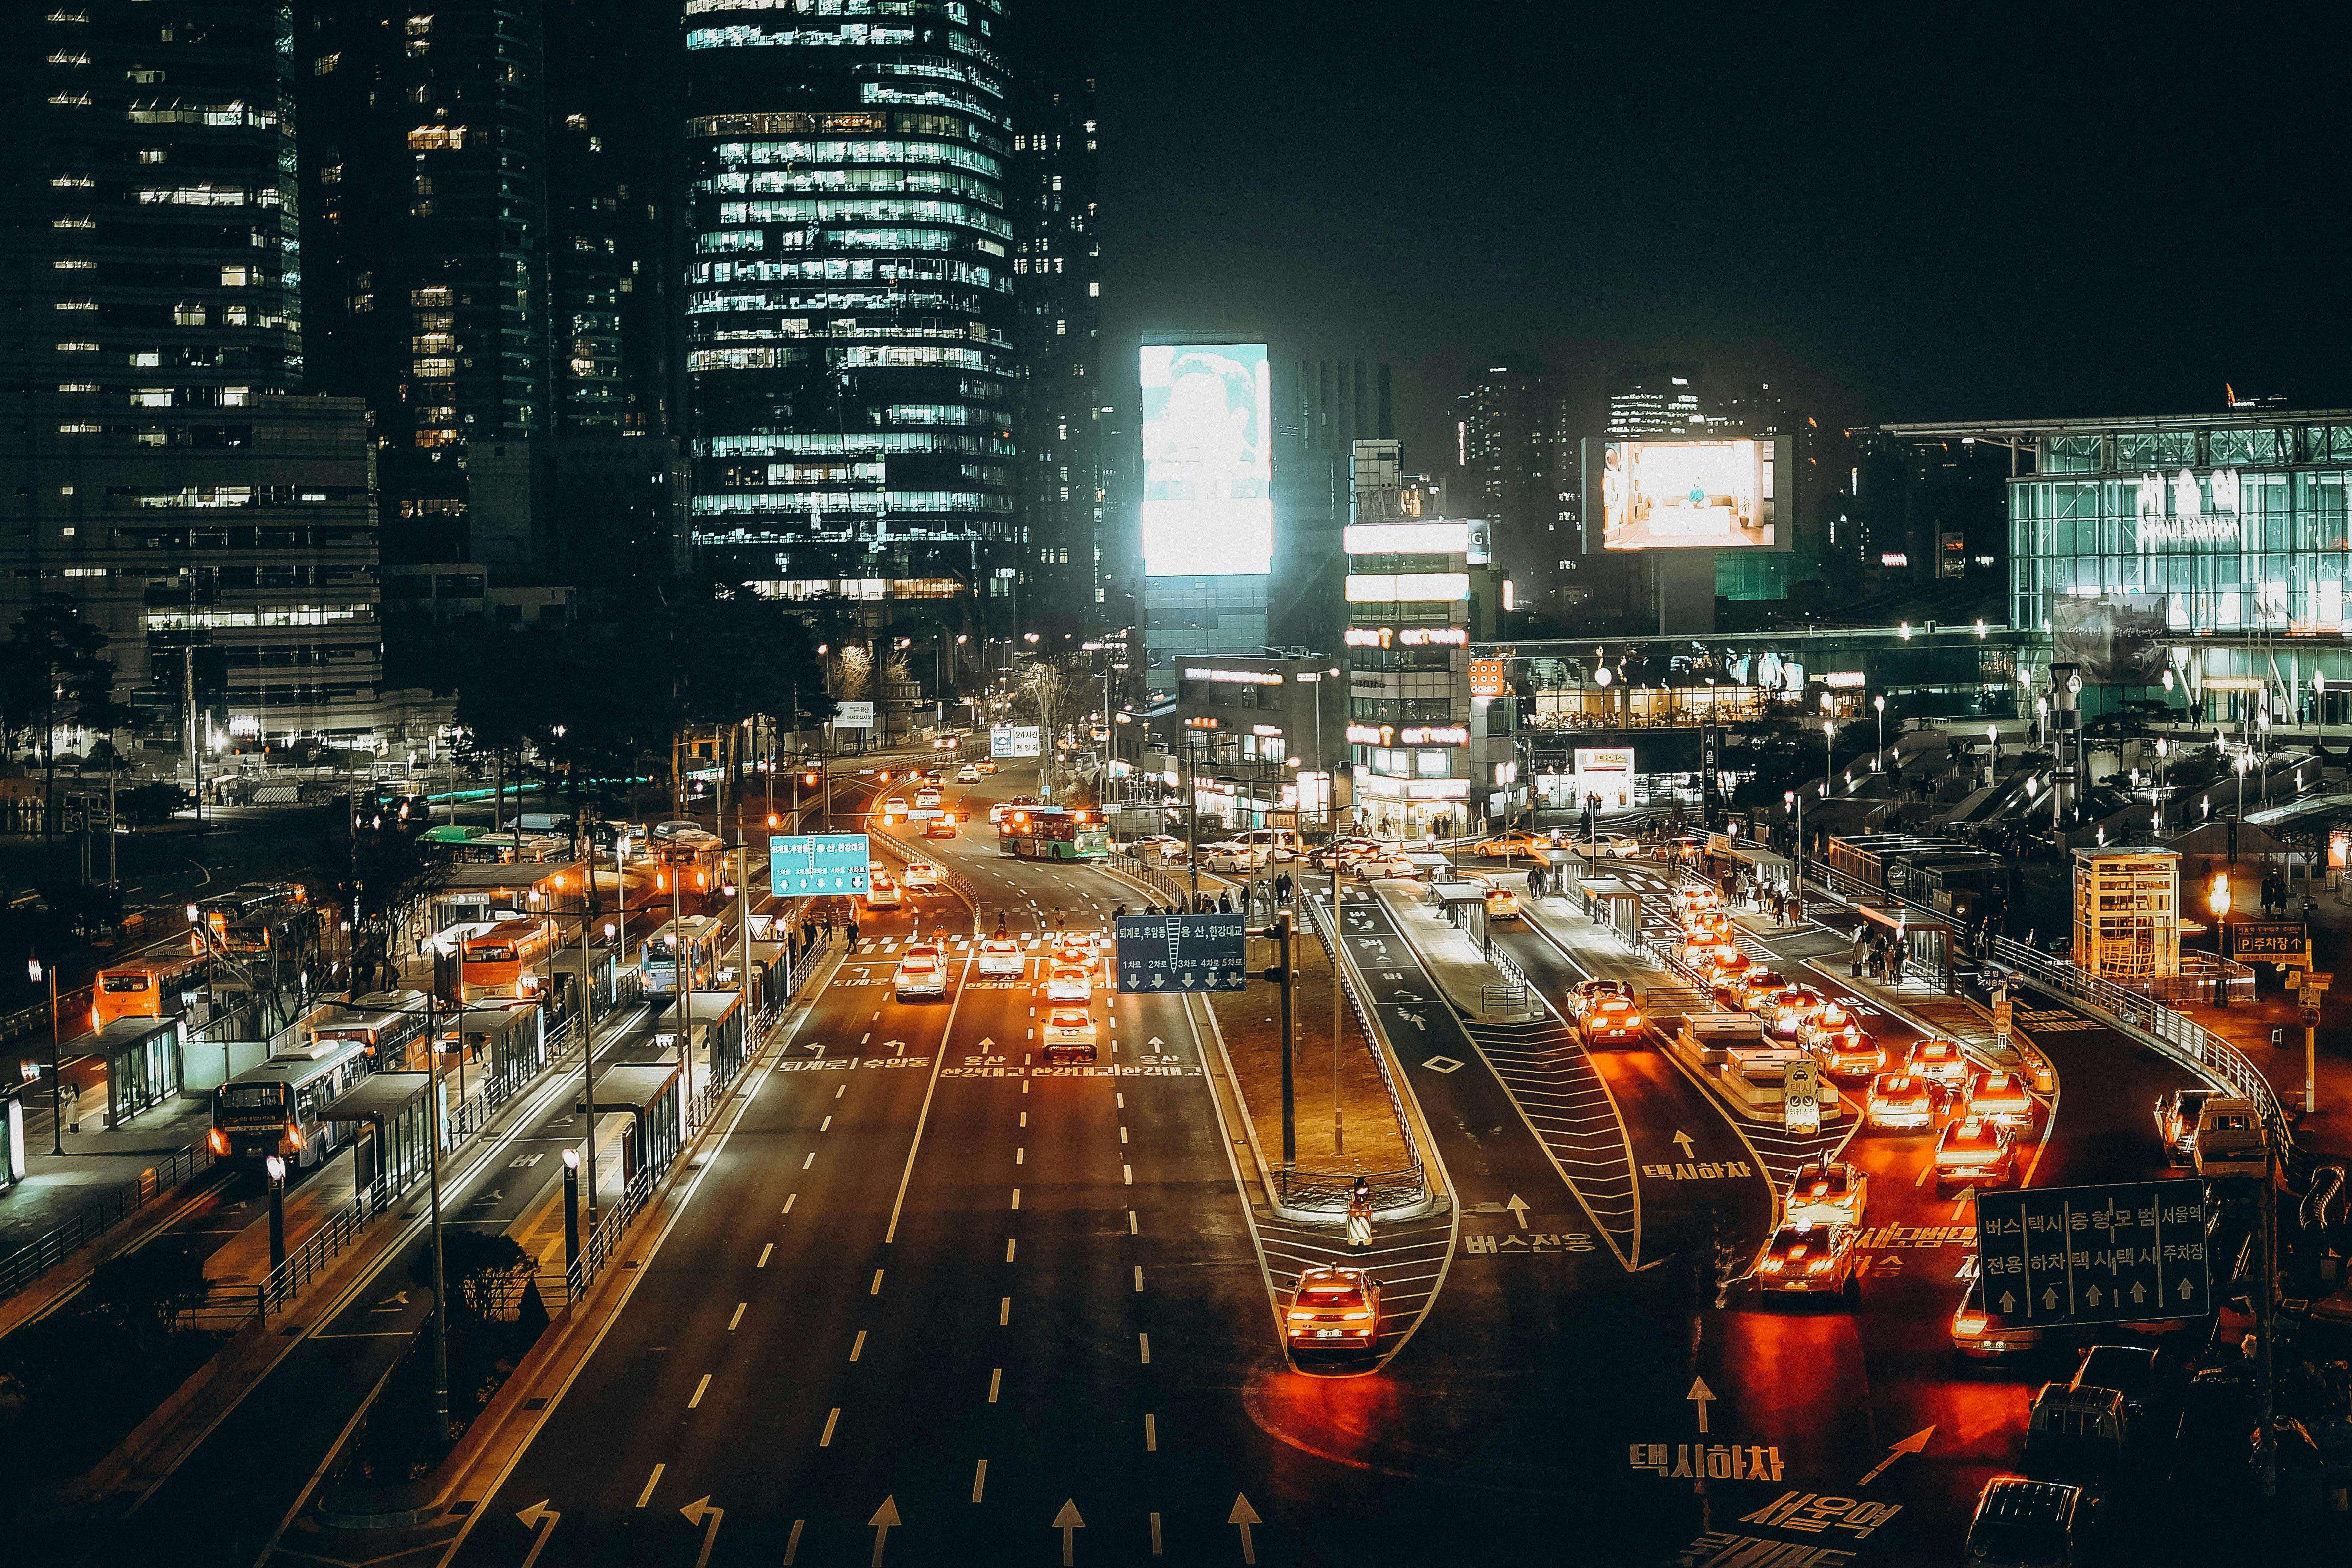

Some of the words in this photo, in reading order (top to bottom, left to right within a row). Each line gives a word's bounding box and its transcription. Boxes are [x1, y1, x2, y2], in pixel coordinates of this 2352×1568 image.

[1705, 734, 1714, 781] 서울역
[2254, 938, 2288, 950] 주차장
[1123, 960, 1142, 969] 1차로
[1148, 960, 1167, 968] 2차로
[1178, 959, 1197, 968] 3차로
[1201, 958, 1220, 967] 4차로
[1222, 958, 1243, 966] 5차로
[778, 1059, 848, 1071] 퇴계로
[862, 1057, 930, 1068] 후암동
[964, 1055, 1006, 1066] 용산
[1140, 1055, 1180, 1065] 용산
[940, 1066, 1025, 1077] 한강대교
[1031, 1066, 1113, 1077] 한강대교
[1122, 1066, 1202, 1077] 한강대교
[1791, 1082, 1811, 1094] 택시
[1642, 1161, 1752, 1181] 택시하차
[1985, 1218, 2021, 1236] 버스
[2028, 1213, 2063, 1233] 택시
[2069, 1210, 2111, 1231] 중형
[2113, 1207, 2155, 1227] 모범
[2161, 1204, 2202, 1225] 서울역
[1464, 1233, 1596, 1253] 버스전용
[1987, 1255, 2023, 1275] 전용
[2030, 1252, 2066, 1272] 하차
[2071, 1249, 2112, 1270] 택시
[2116, 1246, 2157, 1267] 택시
[2163, 1242, 2204, 1263] 주차장
[1630, 1444, 1785, 1481] 택시하차
[1738, 1490, 1903, 1539] 서울역
